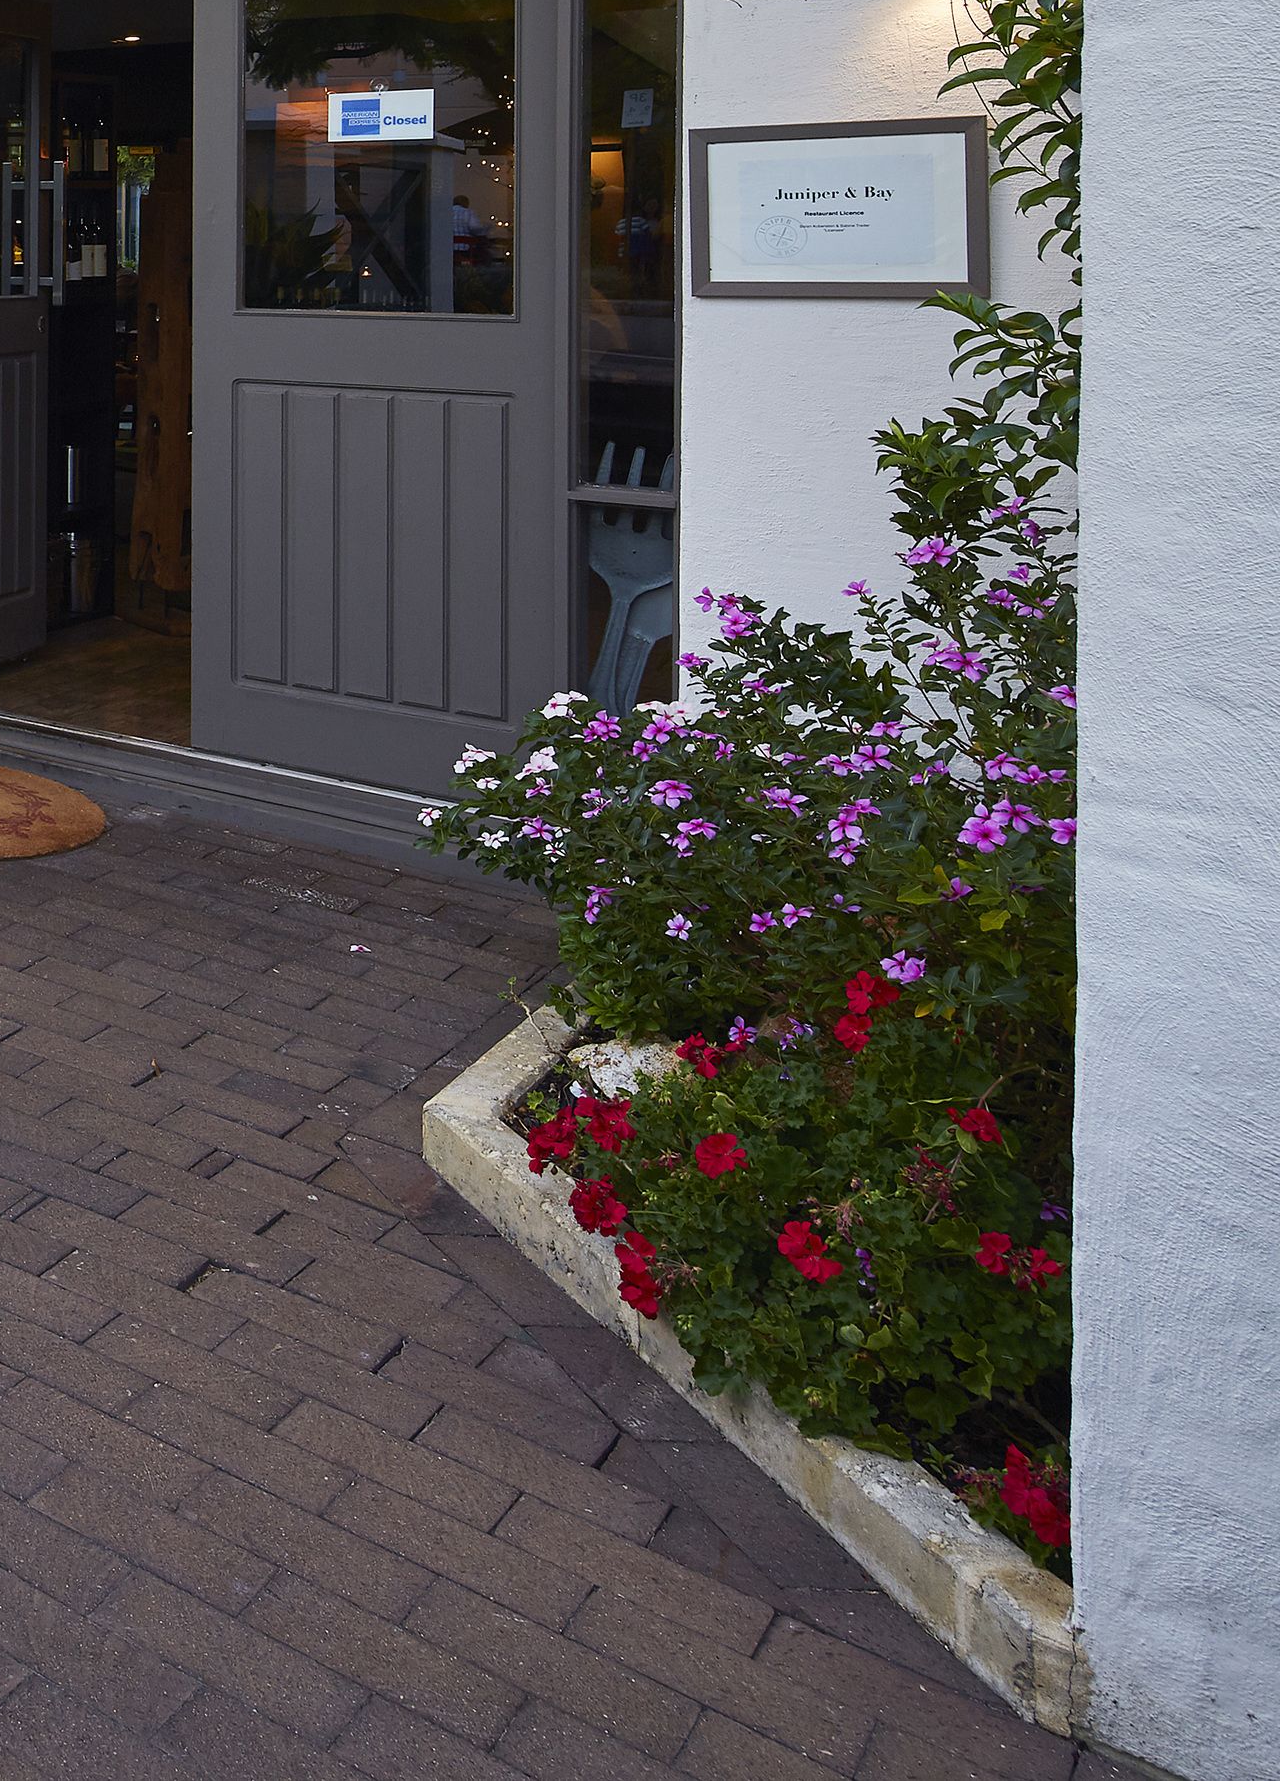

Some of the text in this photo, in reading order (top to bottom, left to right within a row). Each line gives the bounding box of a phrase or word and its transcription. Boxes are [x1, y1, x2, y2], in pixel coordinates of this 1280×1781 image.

[383, 115, 427, 126] Closed
[775, 186, 895, 203] Juniper & Bay
